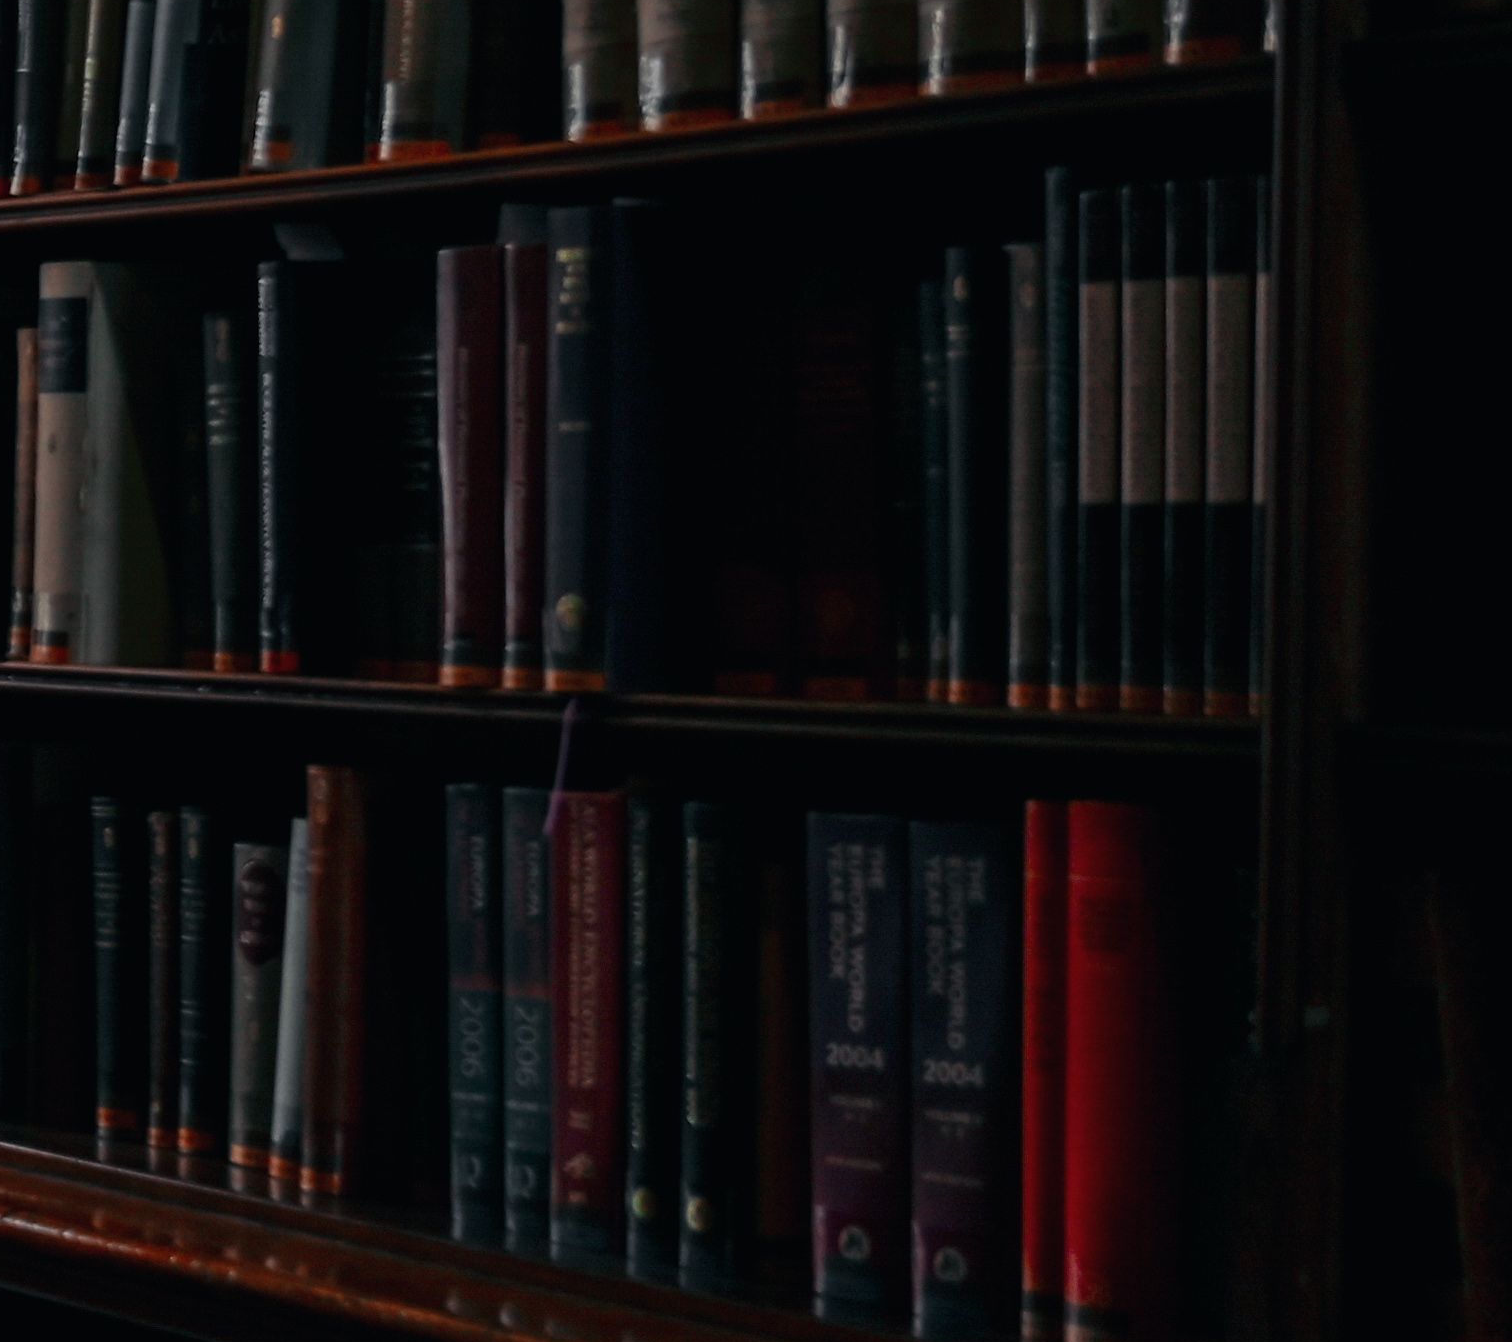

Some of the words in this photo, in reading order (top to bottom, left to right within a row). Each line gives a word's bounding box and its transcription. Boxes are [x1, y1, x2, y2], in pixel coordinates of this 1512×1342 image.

[457, 997, 484, 1077] 2006
[515, 1006, 540, 1088] 2006
[824, 1041, 885, 1070] 2004
[922, 1059, 986, 1089] 2004
